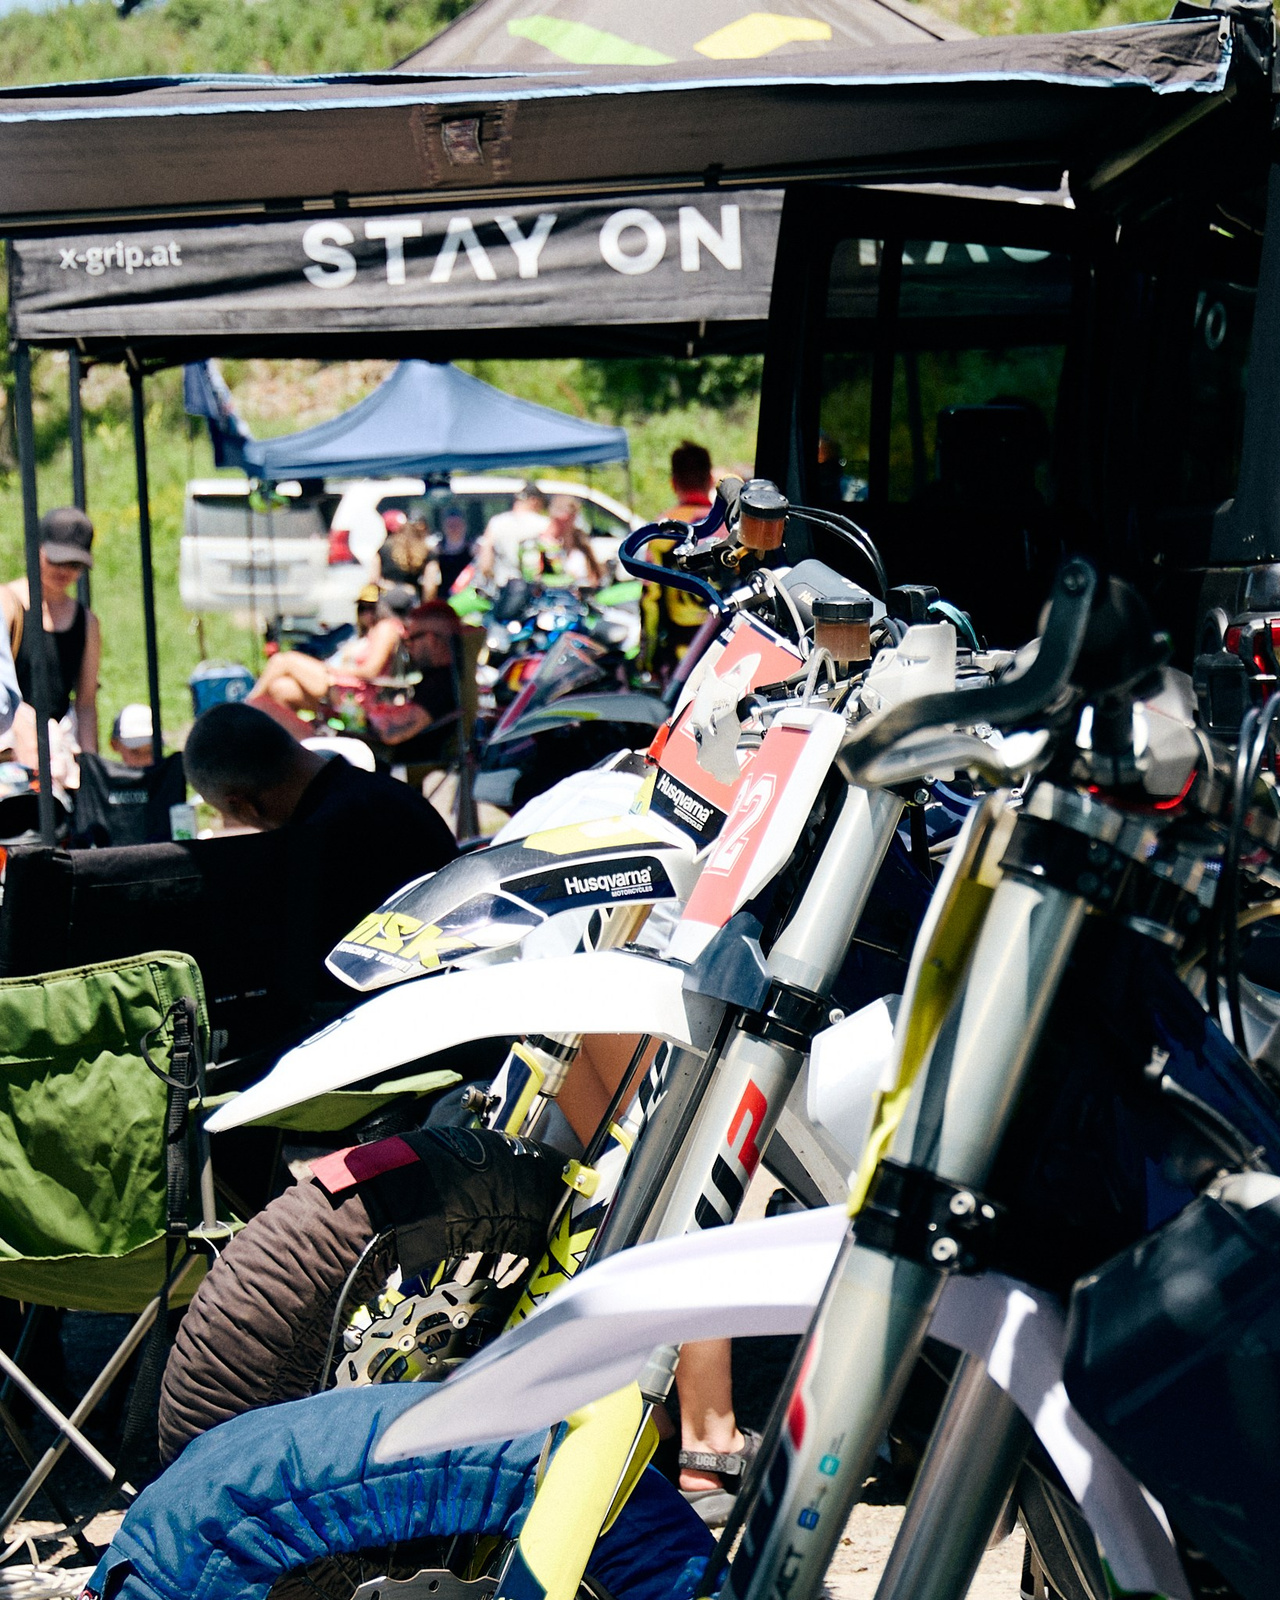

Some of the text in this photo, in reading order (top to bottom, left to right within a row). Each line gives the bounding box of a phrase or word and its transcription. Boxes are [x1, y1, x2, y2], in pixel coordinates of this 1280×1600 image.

[58, 241, 183, 276] x-grip.at
[301, 204, 743, 291] STAY ON
[656, 773, 714, 823] Husqvarna
[564, 866, 652, 895] Husqvarna
[611, 885, 653, 897] MOTORCYCLES
[695, 1455, 717, 1467] UGG
